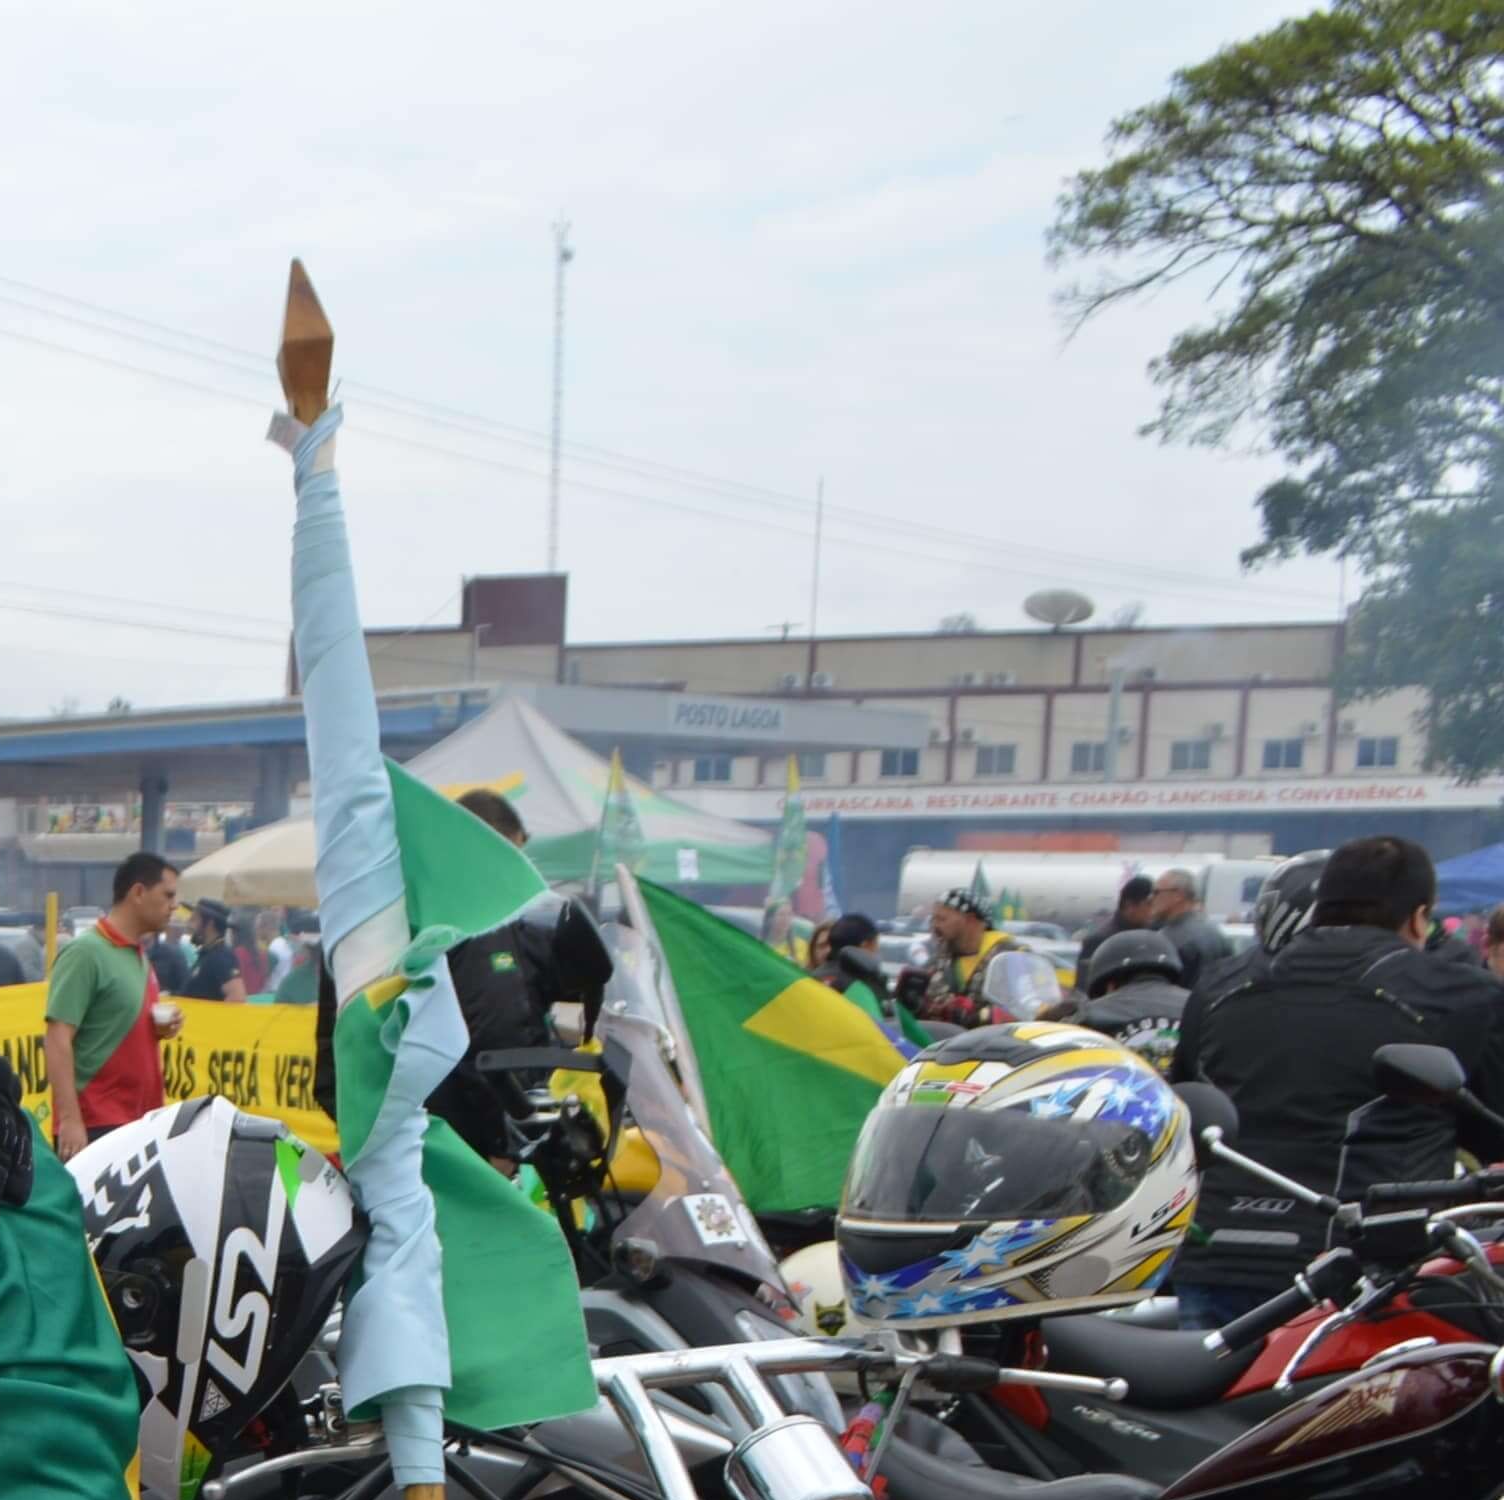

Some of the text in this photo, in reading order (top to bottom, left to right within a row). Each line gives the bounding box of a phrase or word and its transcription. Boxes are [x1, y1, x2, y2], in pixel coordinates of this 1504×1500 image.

[674, 703, 782, 729] POSTO LAGOA
[777, 795, 913, 812] CURRASCARIA
[927, 791, 1058, 808] RESTAURANTE
[207, 1040, 261, 1106] SERÁ
[274, 1053, 323, 1111] VER
[1130, 1188, 1188, 1239] LS2
